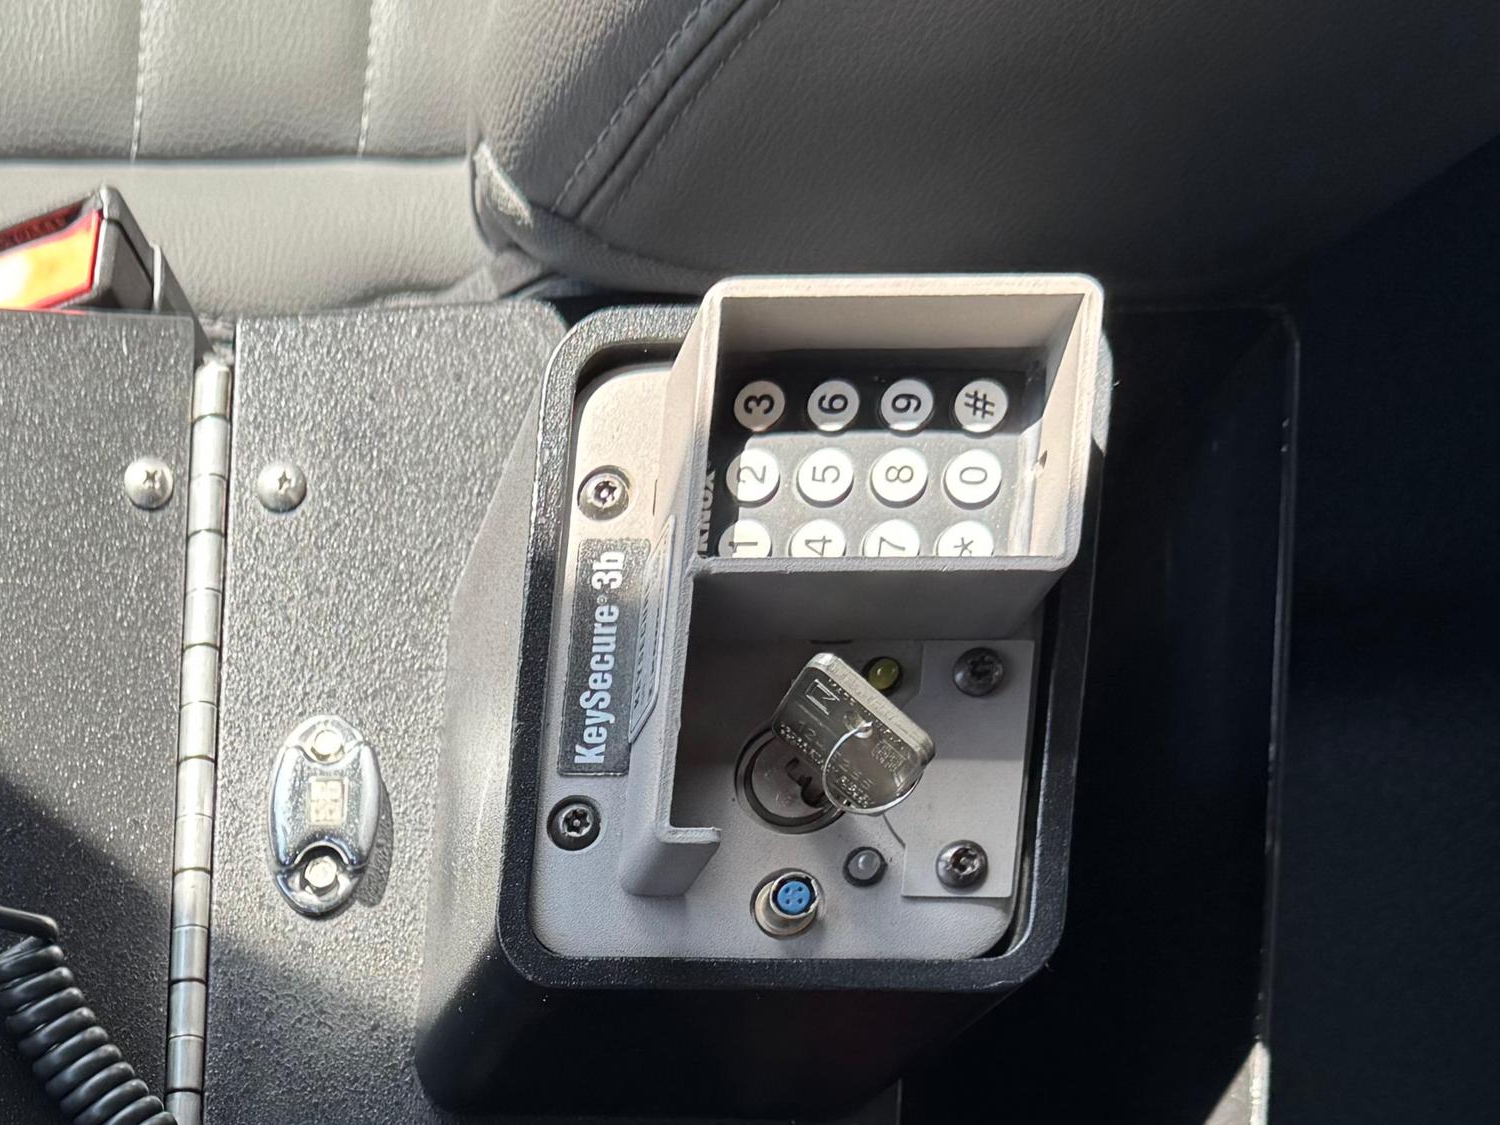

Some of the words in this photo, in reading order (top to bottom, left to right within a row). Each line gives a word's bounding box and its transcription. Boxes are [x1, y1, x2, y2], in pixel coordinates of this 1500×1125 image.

[744, 393, 774, 414] 3
[818, 393, 848, 414] 6
[891, 393, 921, 413] 9
[964, 390, 995, 419] #
[737, 465, 767, 484] 2
[812, 465, 840, 484] 5
[885, 465, 914, 484] 8
[959, 466, 988, 485] 0
[805, 535, 832, 555] 4
[879, 537, 906, 555] 7
[592, 551, 626, 590] 3b
